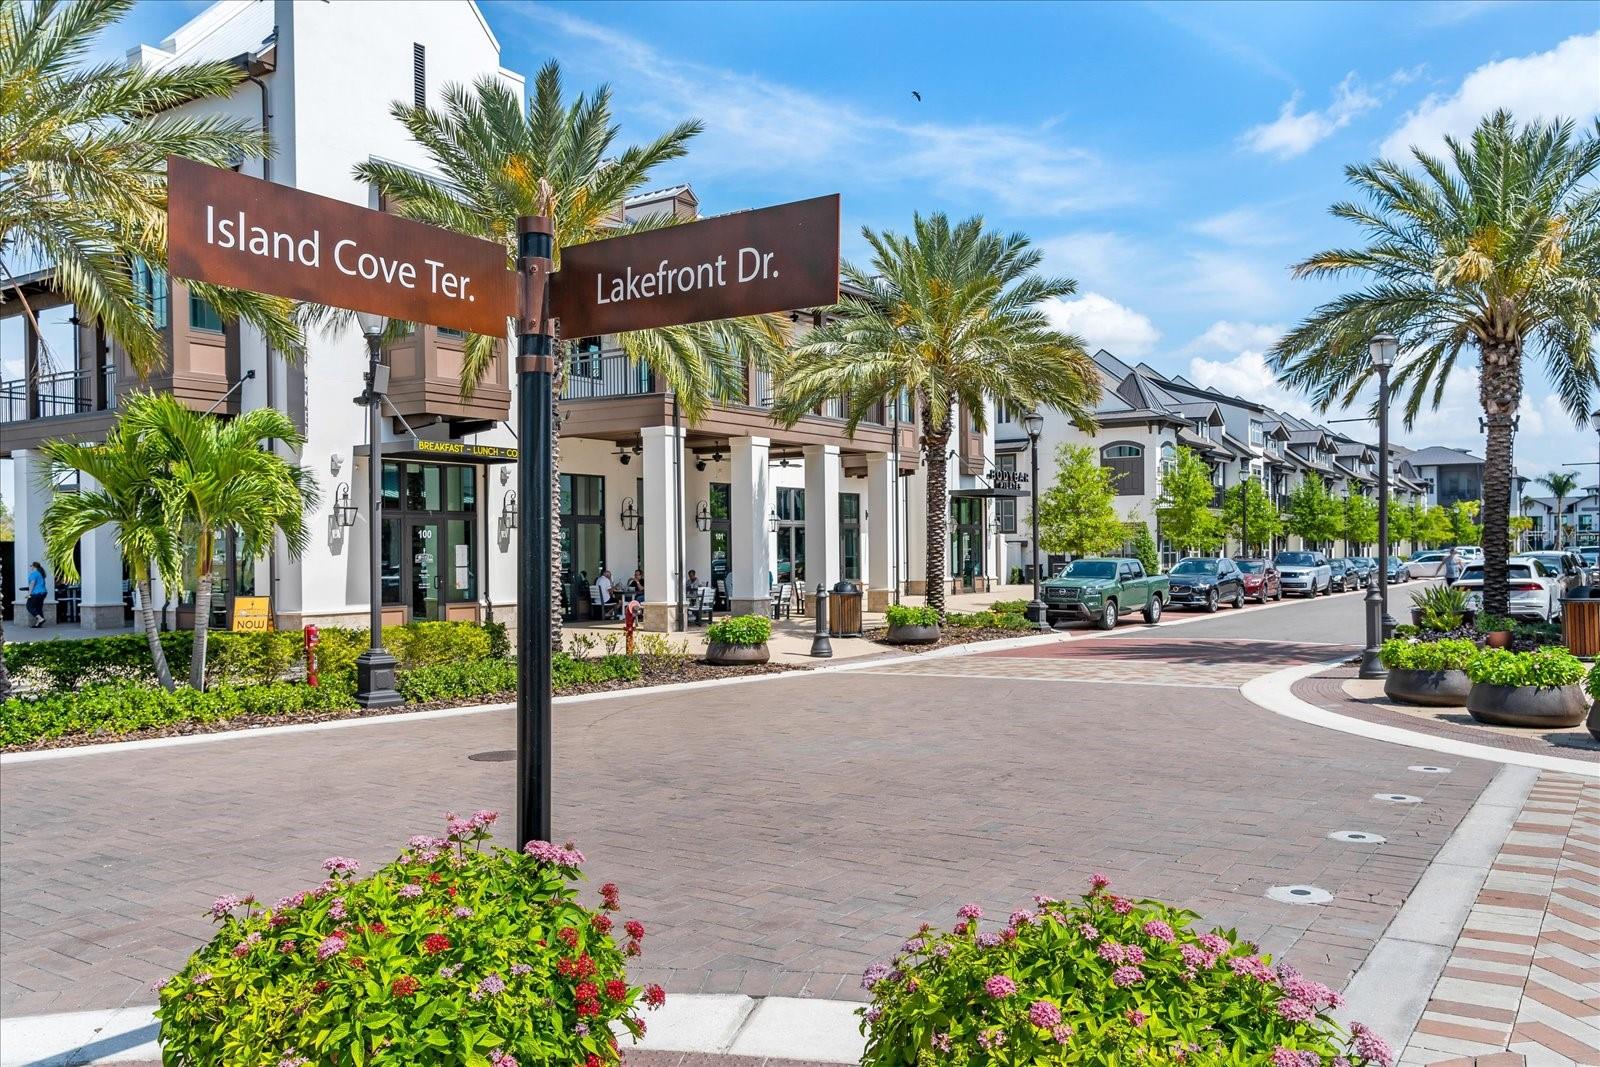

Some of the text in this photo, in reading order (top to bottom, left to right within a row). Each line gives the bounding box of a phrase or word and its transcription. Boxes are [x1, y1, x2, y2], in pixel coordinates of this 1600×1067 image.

[205, 204, 475, 302] Island Cove Ter.
[597, 247, 779, 305] Lakefront Dr.
[418, 441, 464, 453] BREAKFAST
[473, 447, 498, 456] LUNCH
[418, 530, 432, 539] 100
[237, 620, 265, 629] NOW
